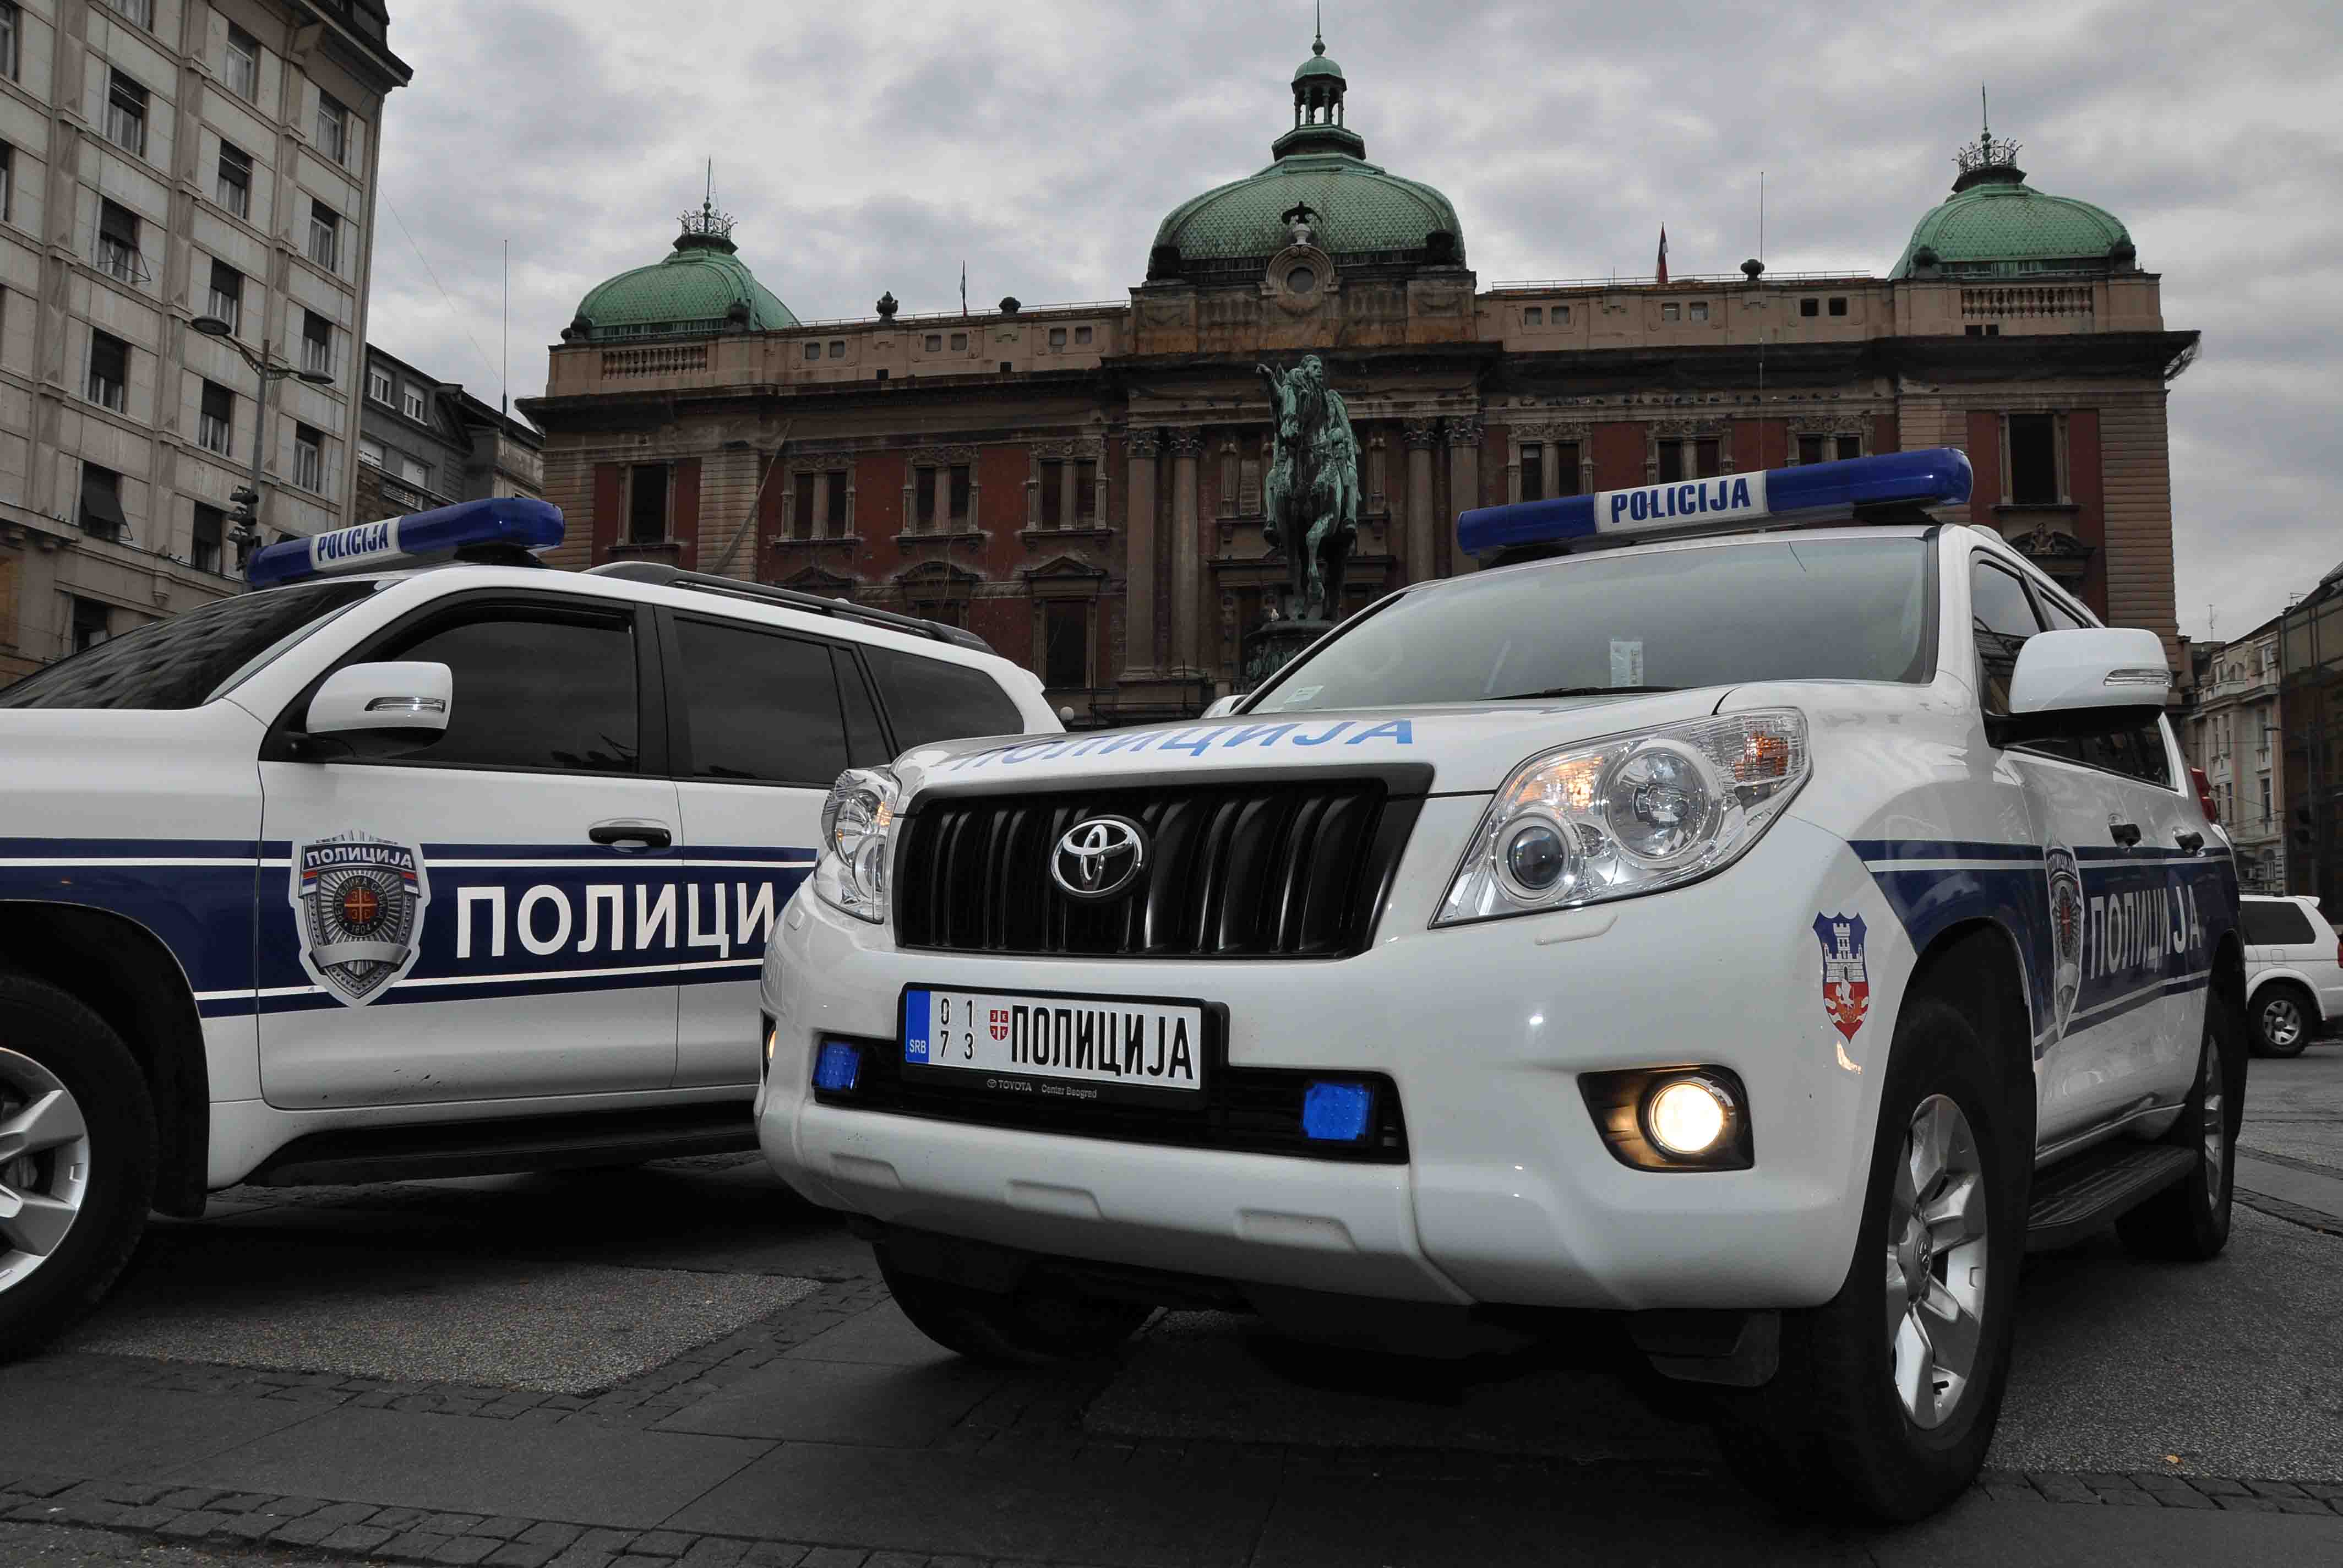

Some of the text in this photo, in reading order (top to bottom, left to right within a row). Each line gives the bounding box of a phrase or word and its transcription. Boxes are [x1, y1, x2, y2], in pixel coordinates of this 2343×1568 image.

[1611, 477, 1752, 524] POLICIJA
[317, 522, 389, 562] POLICIJA
[306, 847, 413, 868] ПОЛИЦИЈА
[2090, 885, 2202, 980] ПОЛИЦИЈА
[909, 1039, 927, 1054] SRB
[1011, 1005, 1194, 1080] ПОЛИЦИЈА
[998, 1080, 1032, 1092] TOYOTA
[1066, 1086, 1097, 1099] Beograd
